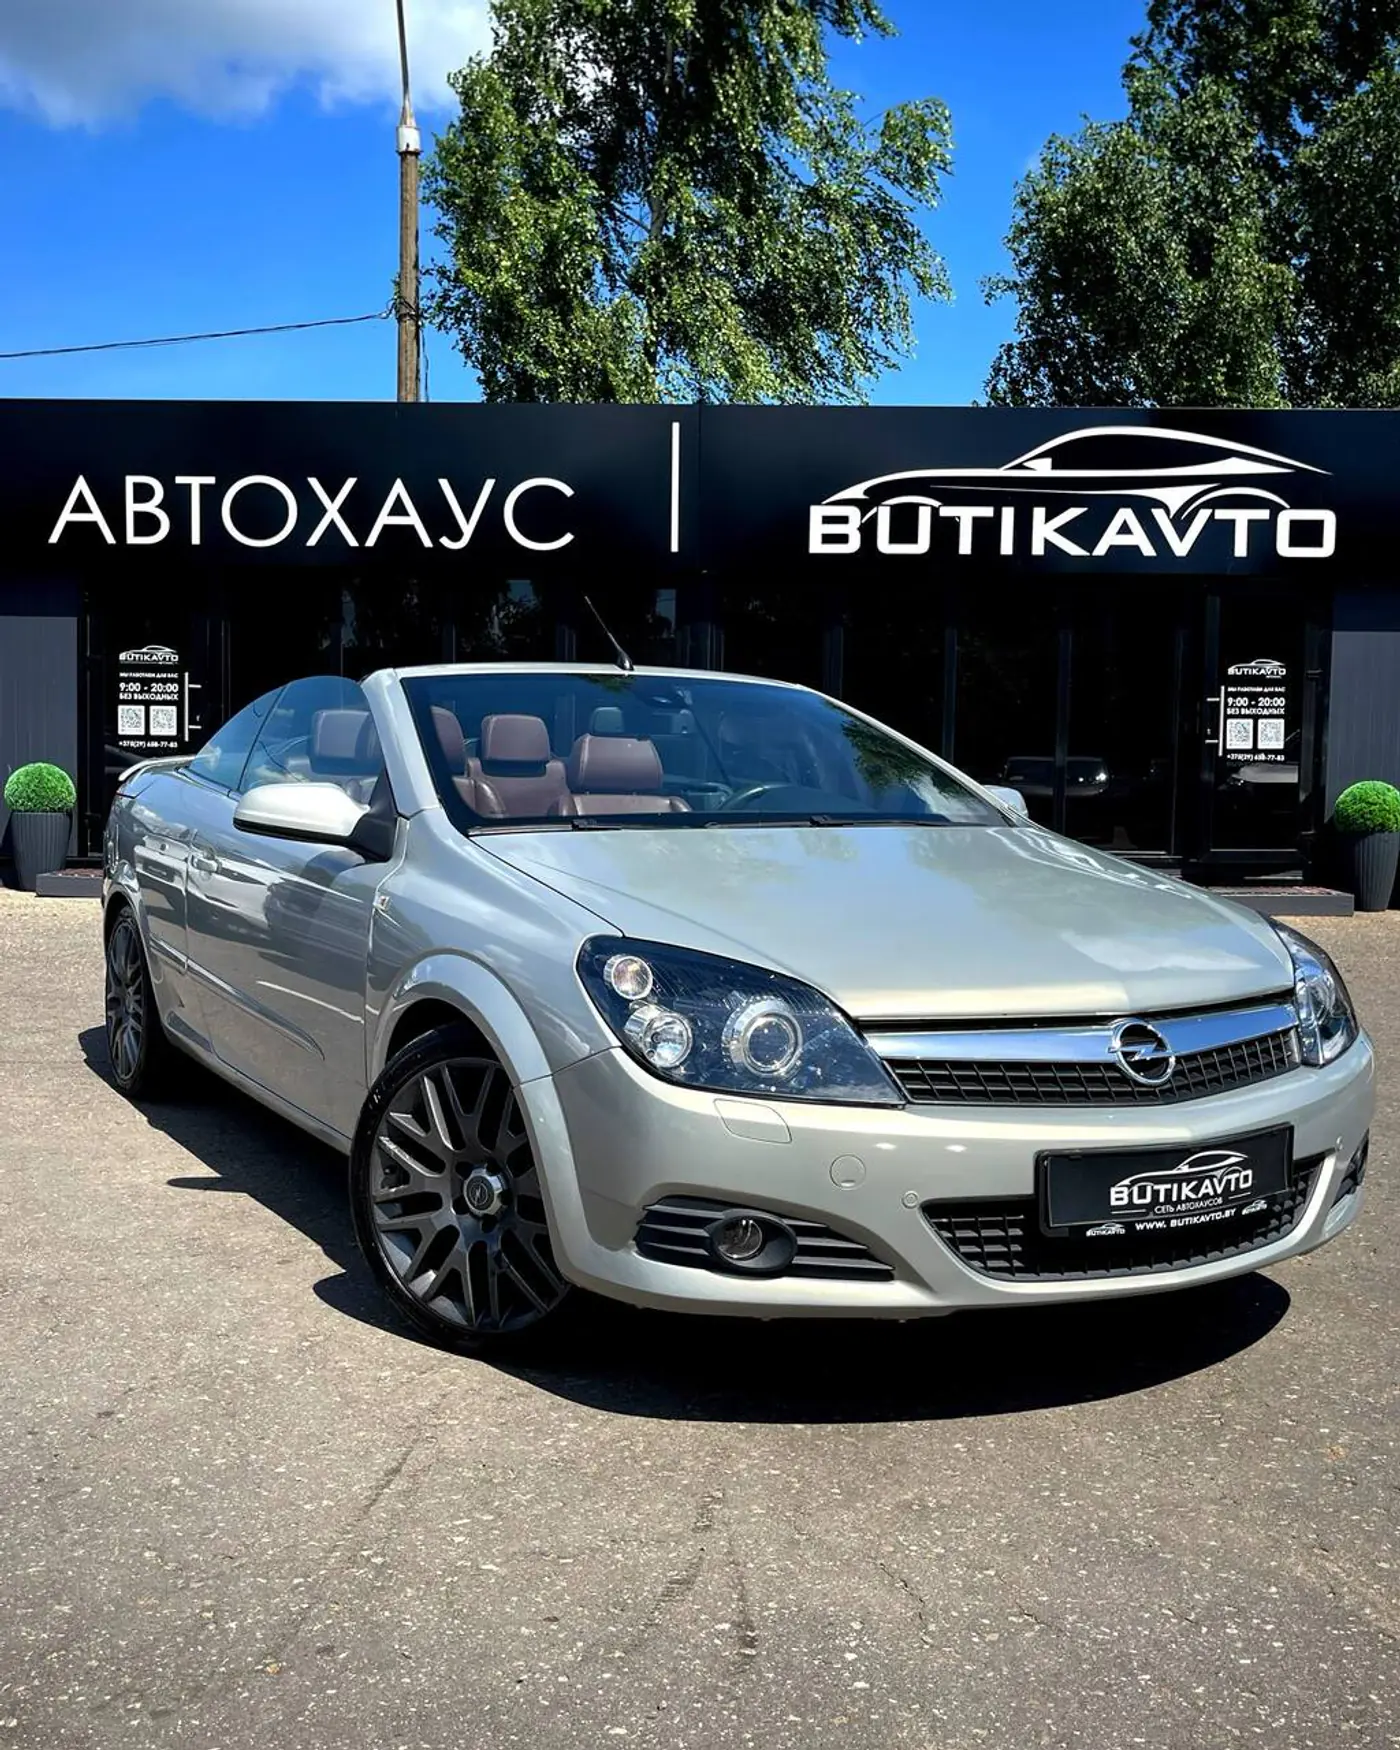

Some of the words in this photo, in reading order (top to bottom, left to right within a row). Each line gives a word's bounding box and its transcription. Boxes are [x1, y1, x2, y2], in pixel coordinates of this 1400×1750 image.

[48, 475, 575, 550] АВТОХАУС
[808, 504, 1337, 559] BUTIKAVTO
[118, 653, 179, 662] BUTIKAVTO
[1227, 667, 1287, 675] BUTIKAVTO
[119, 682, 141, 692] 9:00
[150, 682, 179, 693] 20:00
[133, 693, 179, 701] ВЫХОДНЫХ
[1227, 696, 1249, 707] 9:00
[1257, 696, 1286, 707] 20:00
[1240, 708, 1285, 716] ВЫХОДНЫХ
[1110, 1169, 1253, 1206] BUTIKAVTO
[1154, 1204, 1175, 1214] СЕТЬ
[1176, 1196, 1223, 1212] АВТОХАУСОВ
[1135, 1220, 1167, 1231] WWW.
[1170, 1208, 1236, 1228] BUTIKAVTO.BY
